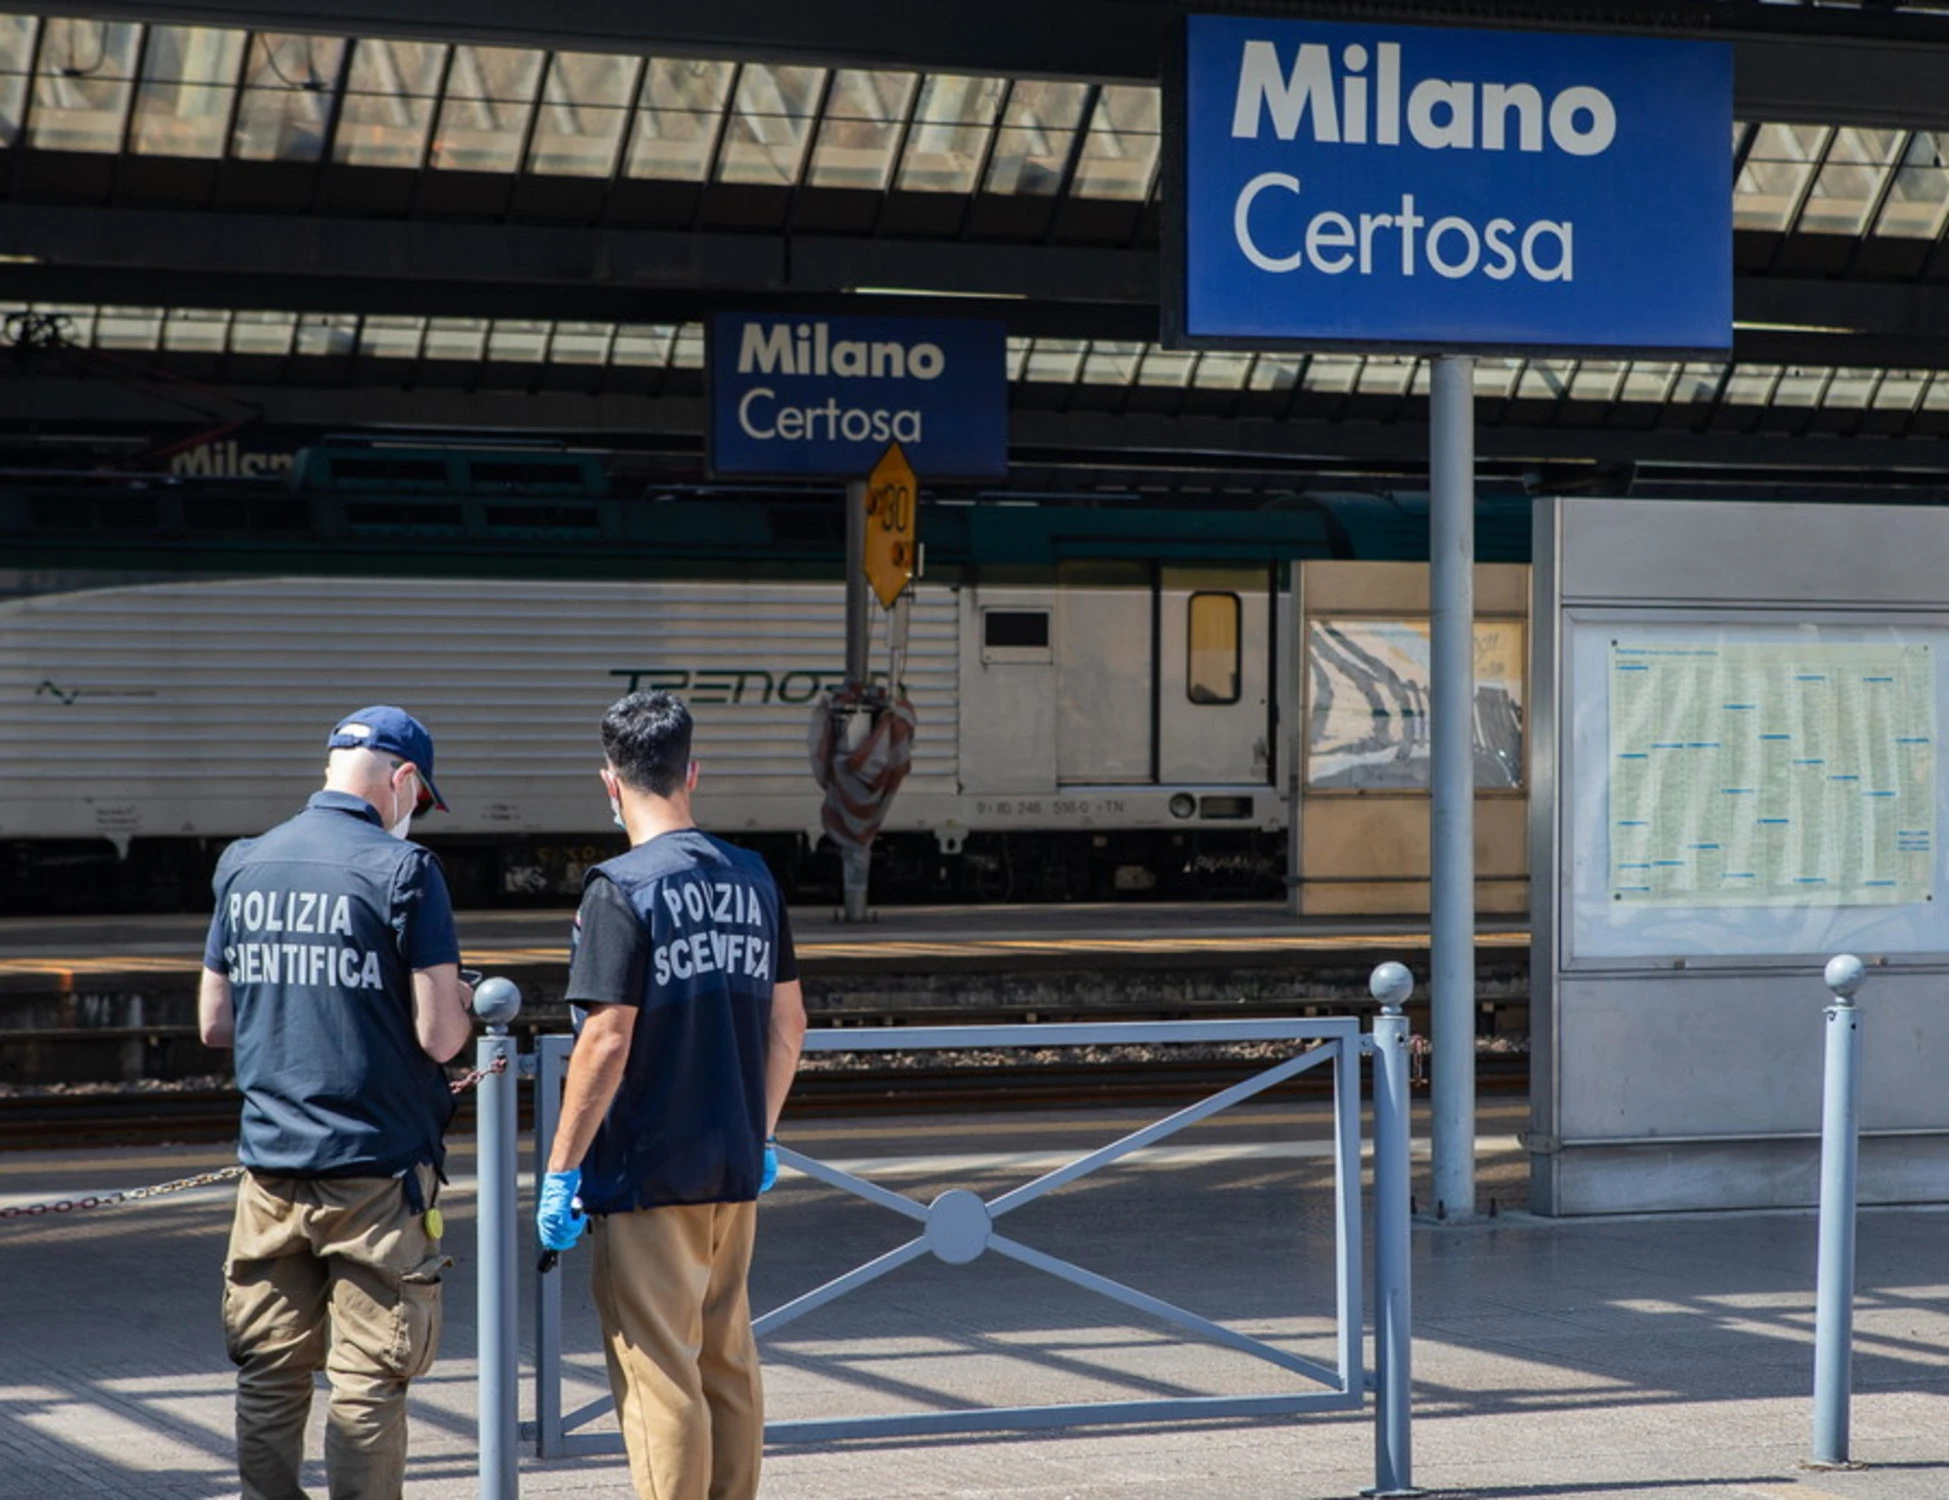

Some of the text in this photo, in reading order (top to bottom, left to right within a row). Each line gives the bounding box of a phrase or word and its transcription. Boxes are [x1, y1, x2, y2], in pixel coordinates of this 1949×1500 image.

[1231, 39, 1617, 156] Milano
[1233, 171, 1573, 282] Certosa
[737, 322, 945, 380] Milano
[738, 387, 922, 443] Certosa
[229, 890, 354, 937] POLIZIA
